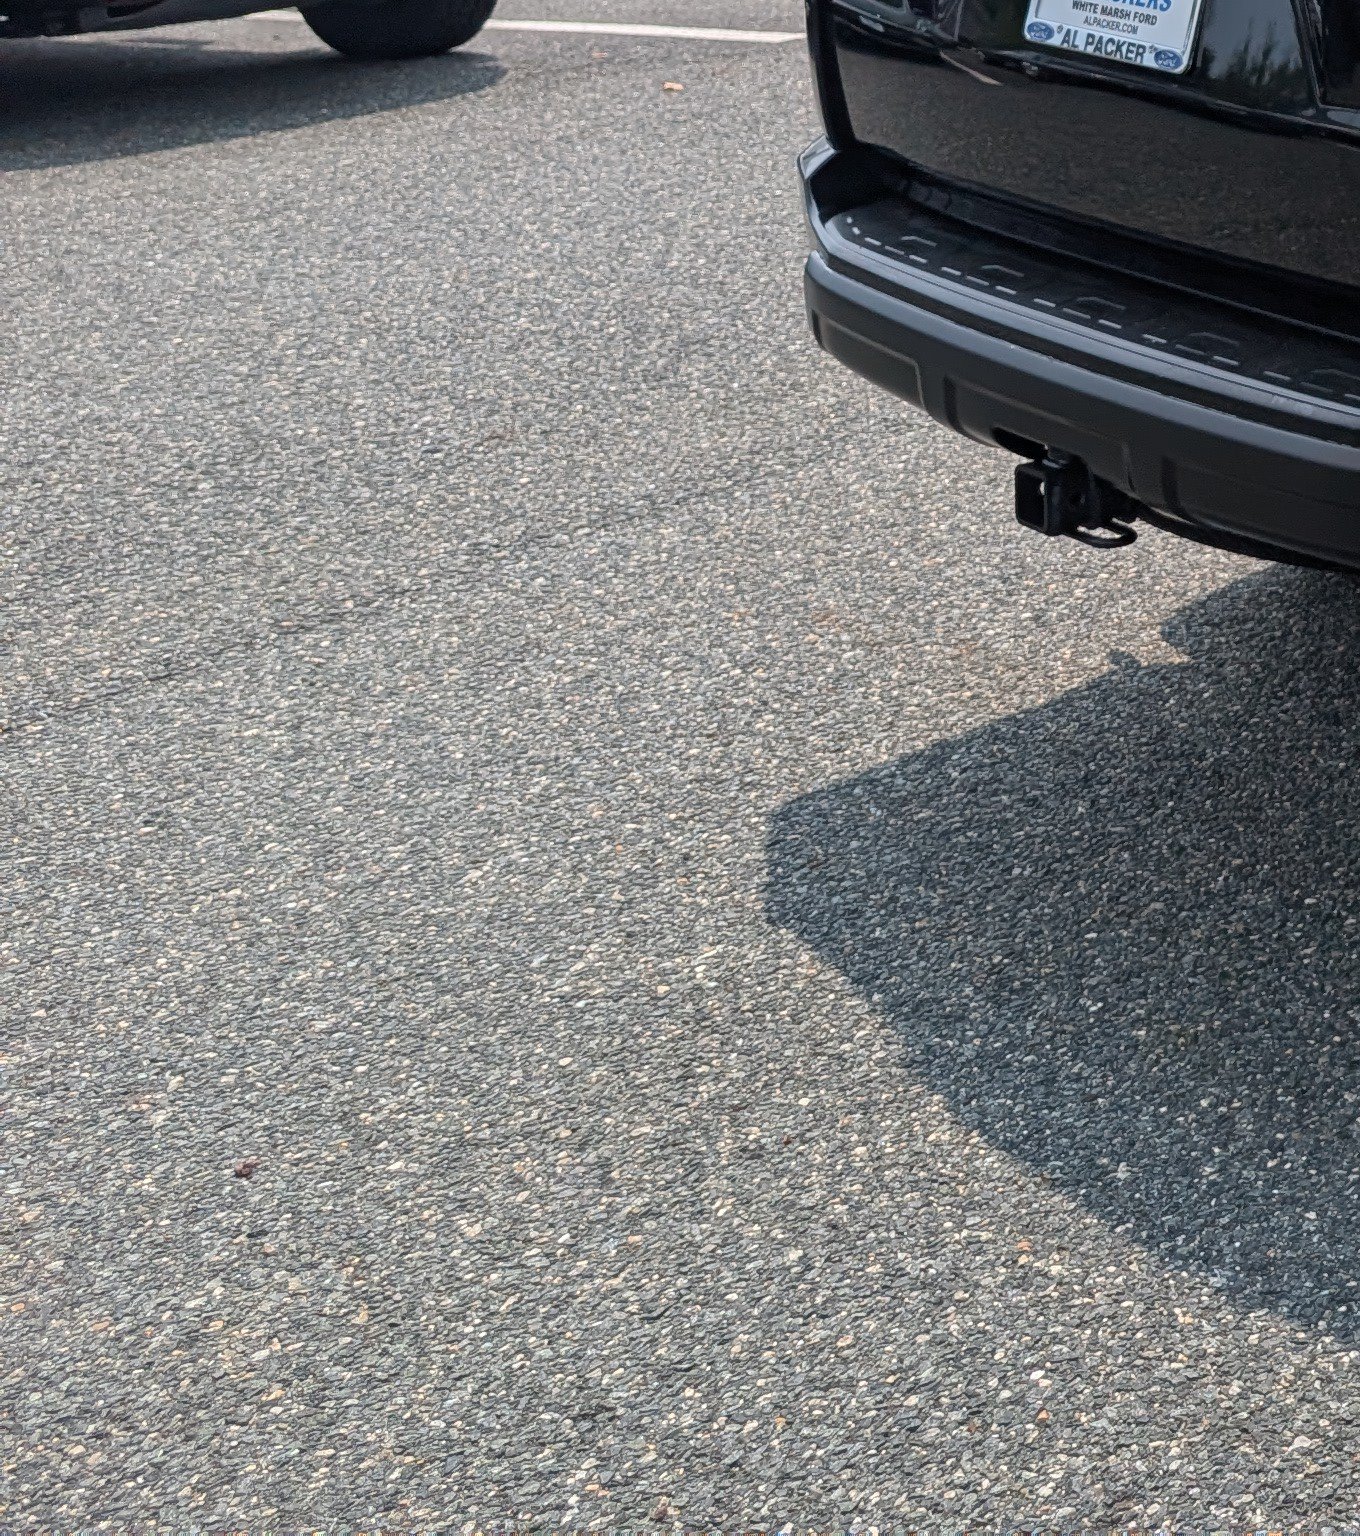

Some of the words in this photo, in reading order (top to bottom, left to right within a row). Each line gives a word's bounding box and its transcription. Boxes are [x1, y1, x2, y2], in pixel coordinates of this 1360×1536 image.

[1072, 0, 1099, 15] WHITE
[1100, 3, 1132, 21] MARSH
[1133, 11, 1158, 26] FORD
[1083, 16, 1139, 35] ALPACKER.COM
[1060, 28, 1081, 49] AL
[1084, 33, 1147, 64] PACKER
